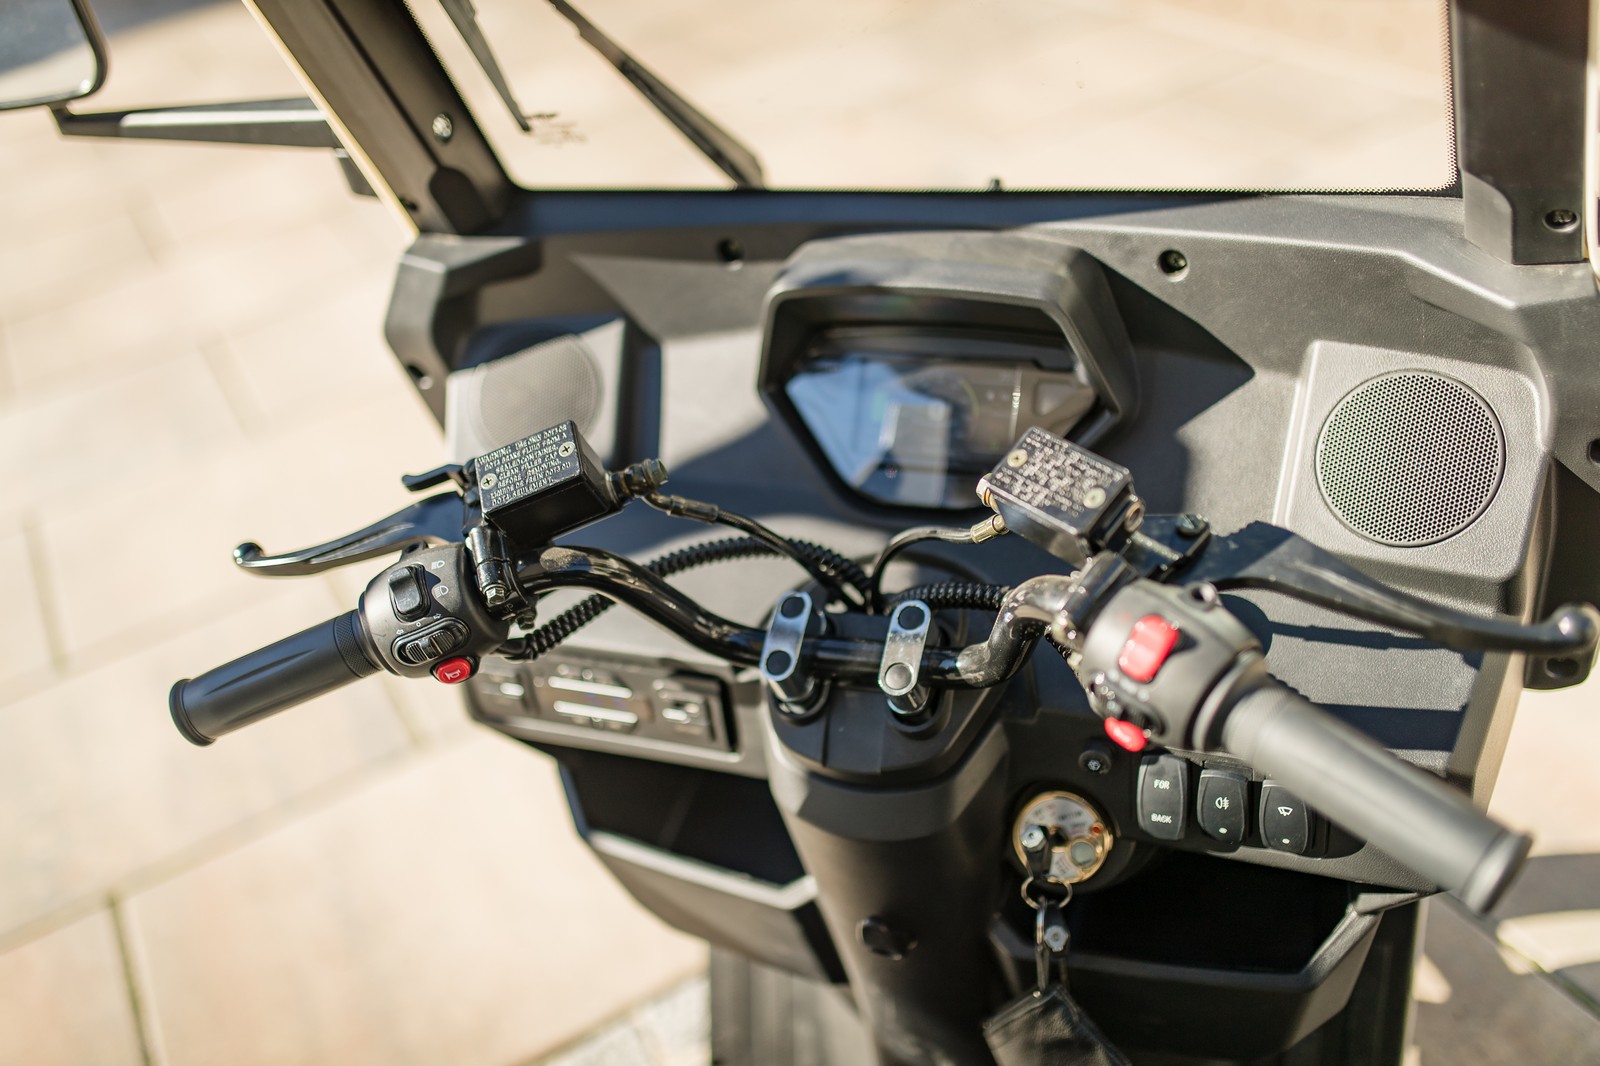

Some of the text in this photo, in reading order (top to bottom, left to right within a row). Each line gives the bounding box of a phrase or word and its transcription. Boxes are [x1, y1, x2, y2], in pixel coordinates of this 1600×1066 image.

[478, 445, 511, 465] WARNING
[1154, 779, 1170, 790] FOR
[1151, 813, 1172, 824] BACK
